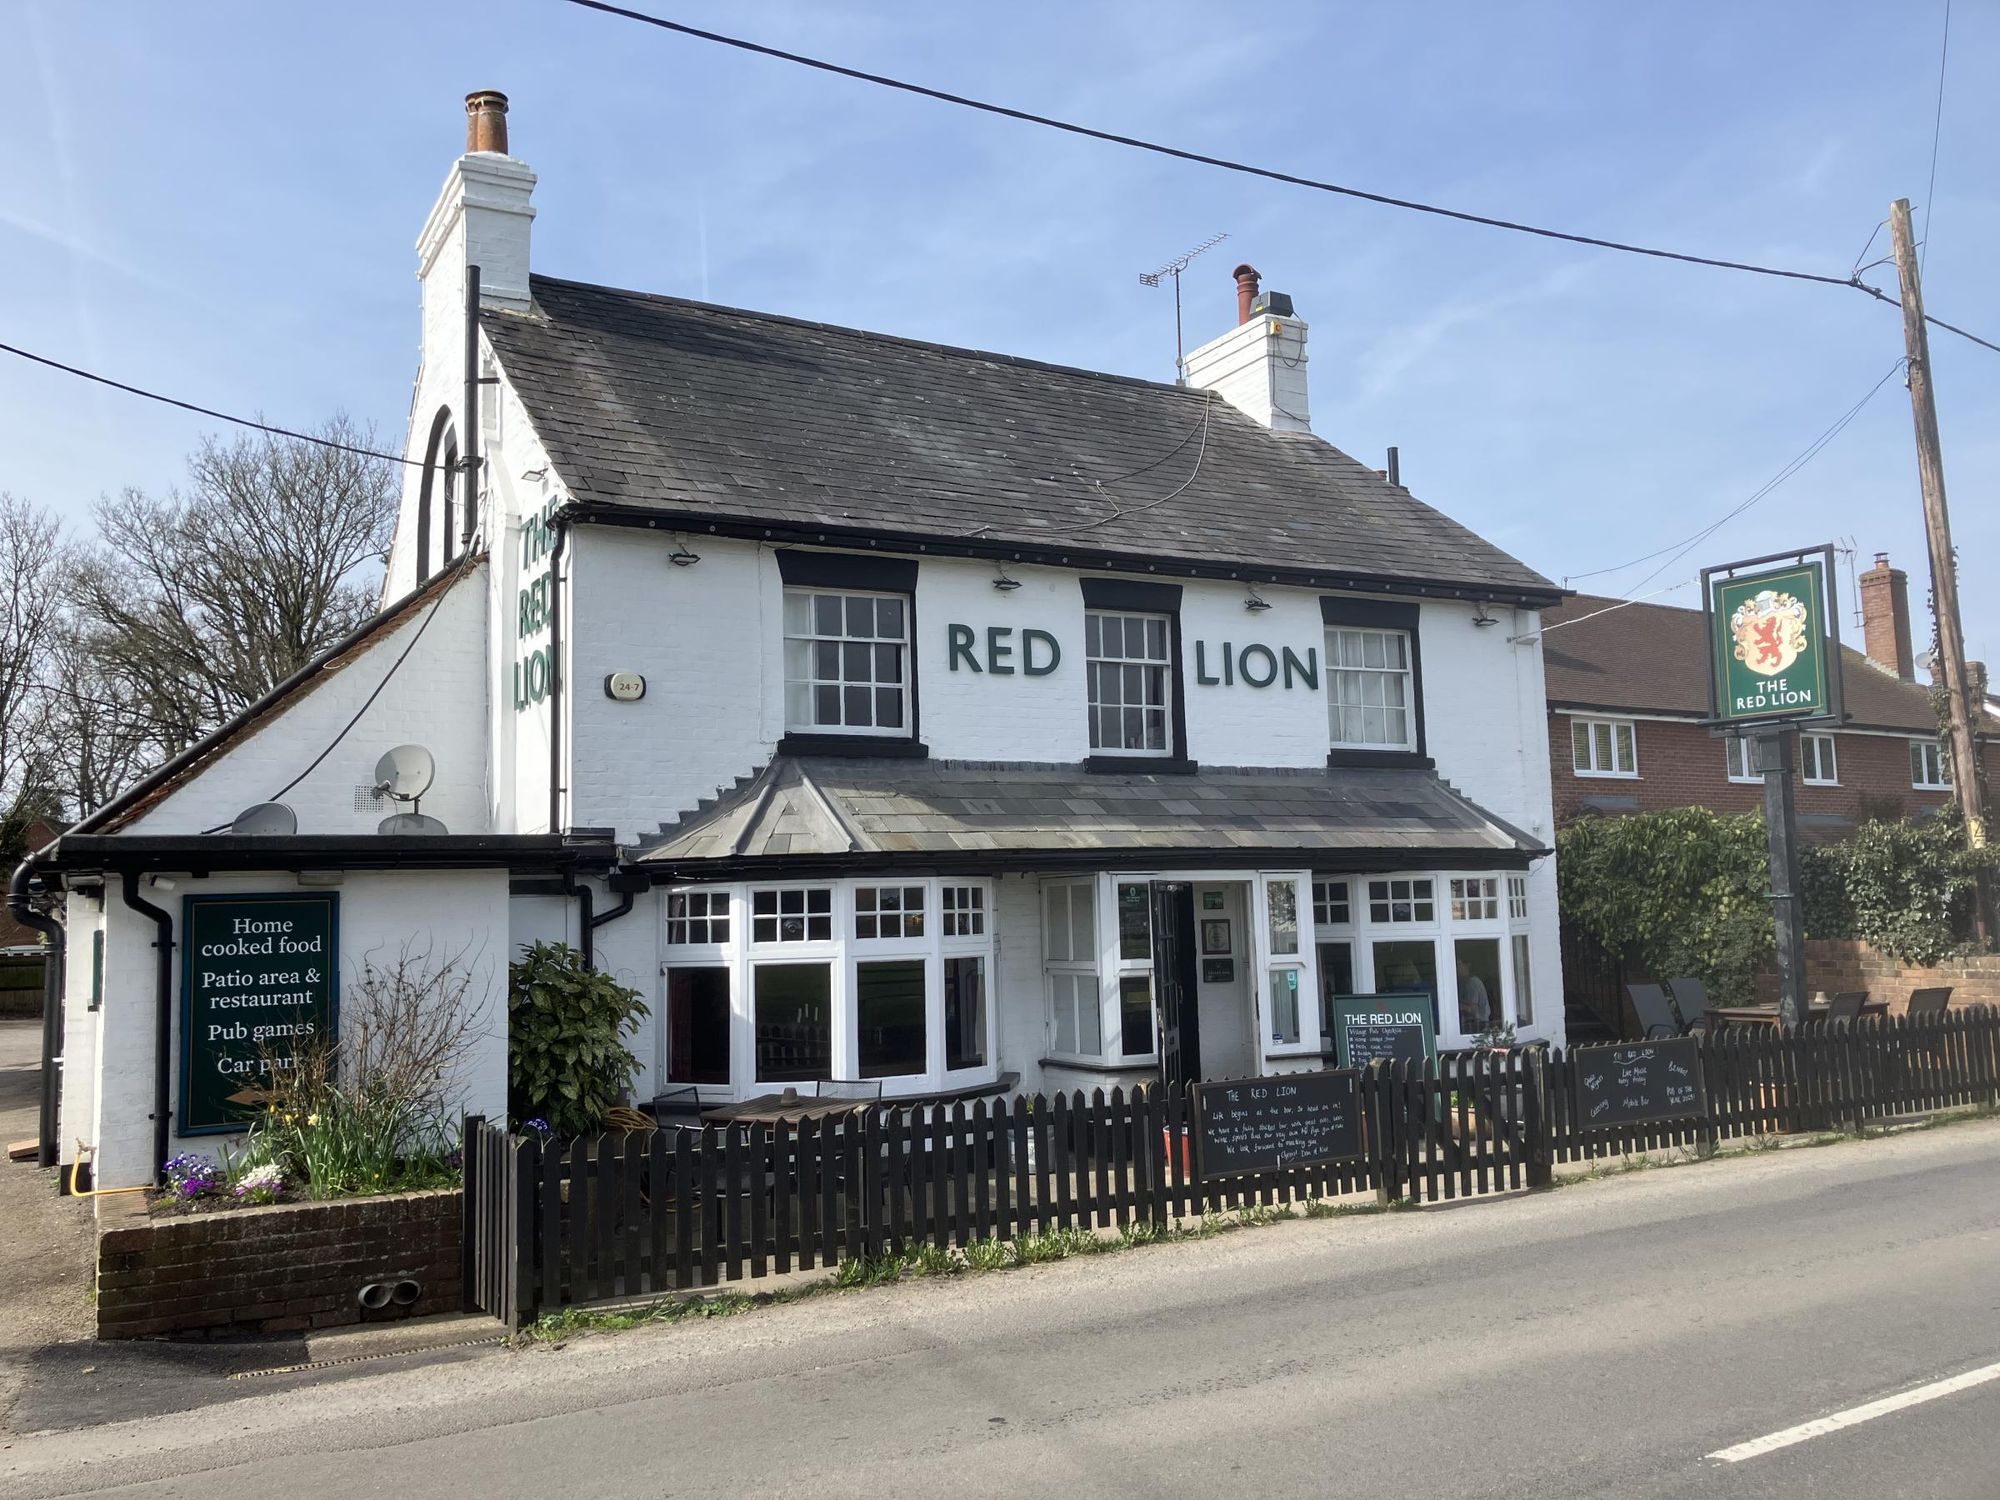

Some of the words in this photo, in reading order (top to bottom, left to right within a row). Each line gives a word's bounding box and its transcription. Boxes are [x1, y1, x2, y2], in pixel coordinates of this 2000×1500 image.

[520, 494, 559, 570] THE
[519, 571, 552, 639] RED
[948, 623, 1061, 677] RED
[1195, 640, 1319, 690] LION
[1755, 679, 1788, 694] THE
[1736, 697, 1766, 710] RED
[1771, 690, 1812, 706] LION
[233, 918, 294, 934] Home
[202, 937, 273, 957] cooked
[279, 935, 322, 954] food
[202, 969, 253, 988] Patio
[258, 970, 300, 986] area
[305, 967, 321, 983] &
[210, 989, 313, 1009] restaurant
[1344, 1014, 1367, 1025] THE
[1370, 1013, 1393, 1025] RED
[1395, 1012, 1422, 1024] LION
[208, 1021, 248, 1041] Pub
[252, 1022, 315, 1042] games
[217, 1057, 254, 1074] Car
[1226, 1089, 1240, 1101] THE
[1251, 1088, 1267, 1099] RED
[1276, 1086, 1297, 1097] LION
[1231, 1110, 1248, 1122] begins
